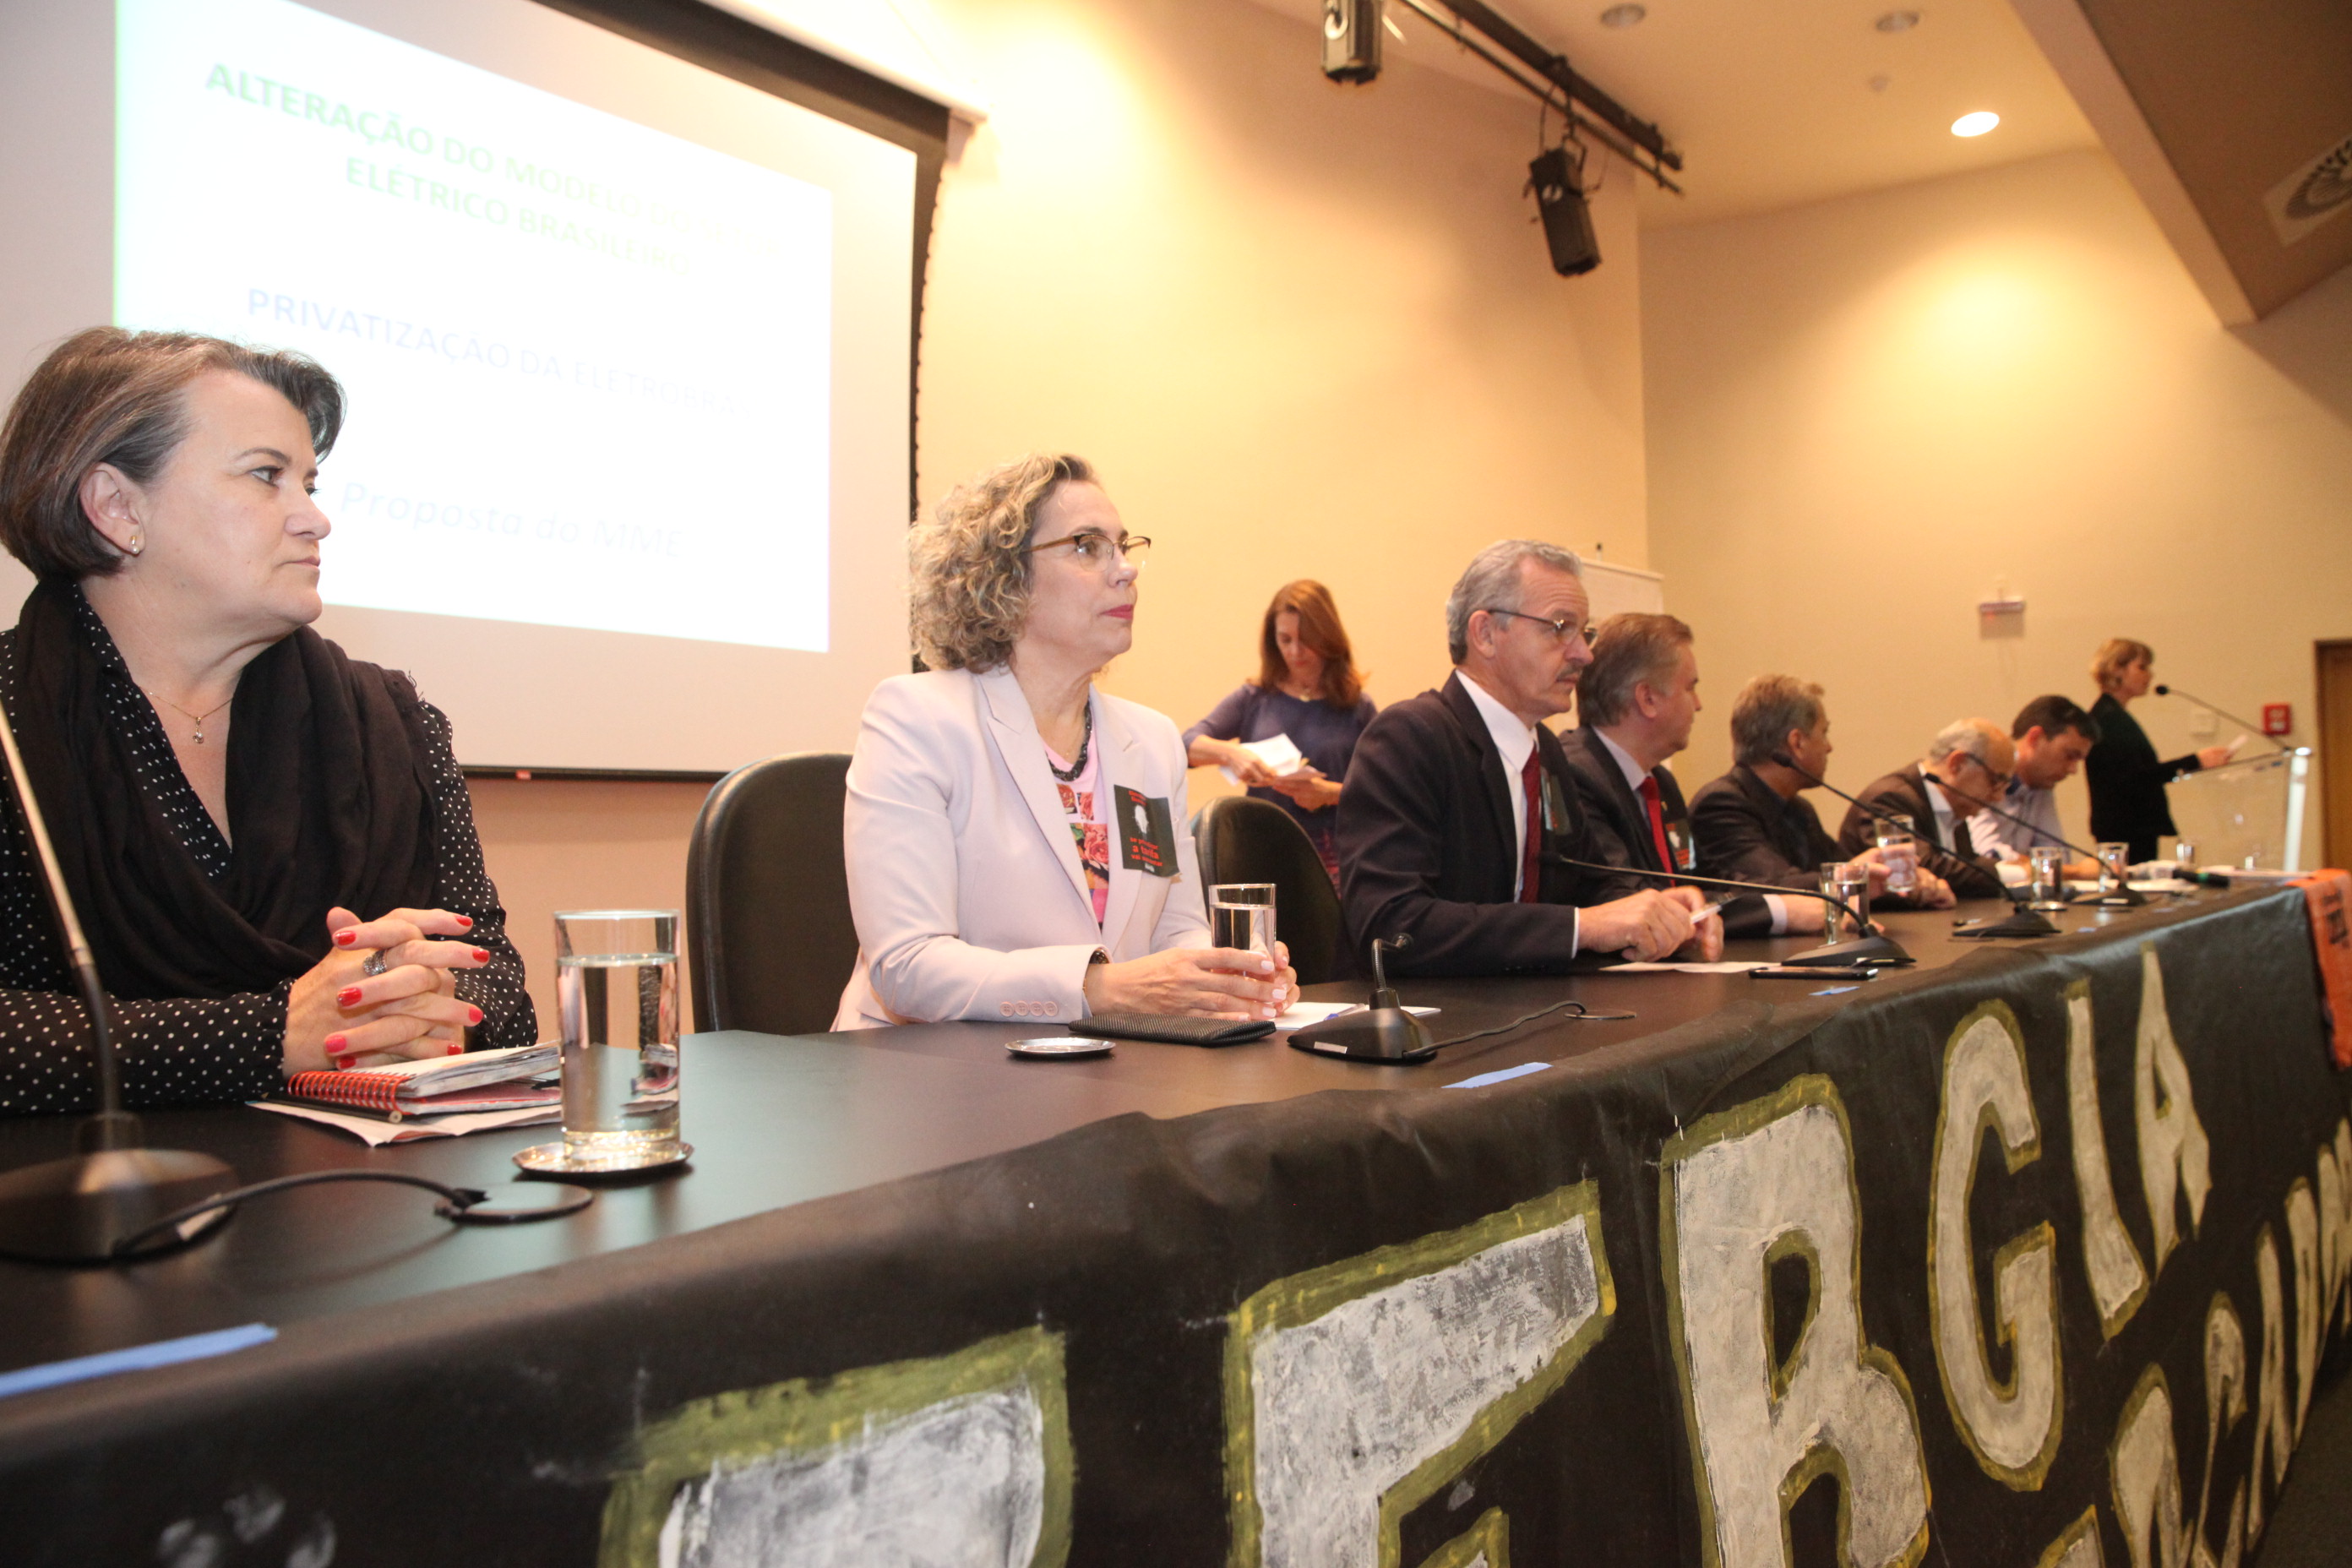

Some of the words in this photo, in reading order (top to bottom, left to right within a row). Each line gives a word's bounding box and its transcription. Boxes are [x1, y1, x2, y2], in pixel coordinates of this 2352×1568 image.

[205, 62, 434, 156] ALTERAÇÃO
[444, 138, 494, 174] DO
[503, 156, 641, 219] MODELO
[649, 200, 692, 234] DO
[346, 154, 509, 226] ELÉTRICO
[519, 208, 691, 278] BRASILEIRO
[248, 287, 511, 371] PRIVATIZAÇÃO
[520, 349, 564, 380] DA
[341, 482, 524, 535] Proposta
[536, 513, 582, 546] do
[593, 519, 687, 559] MME
